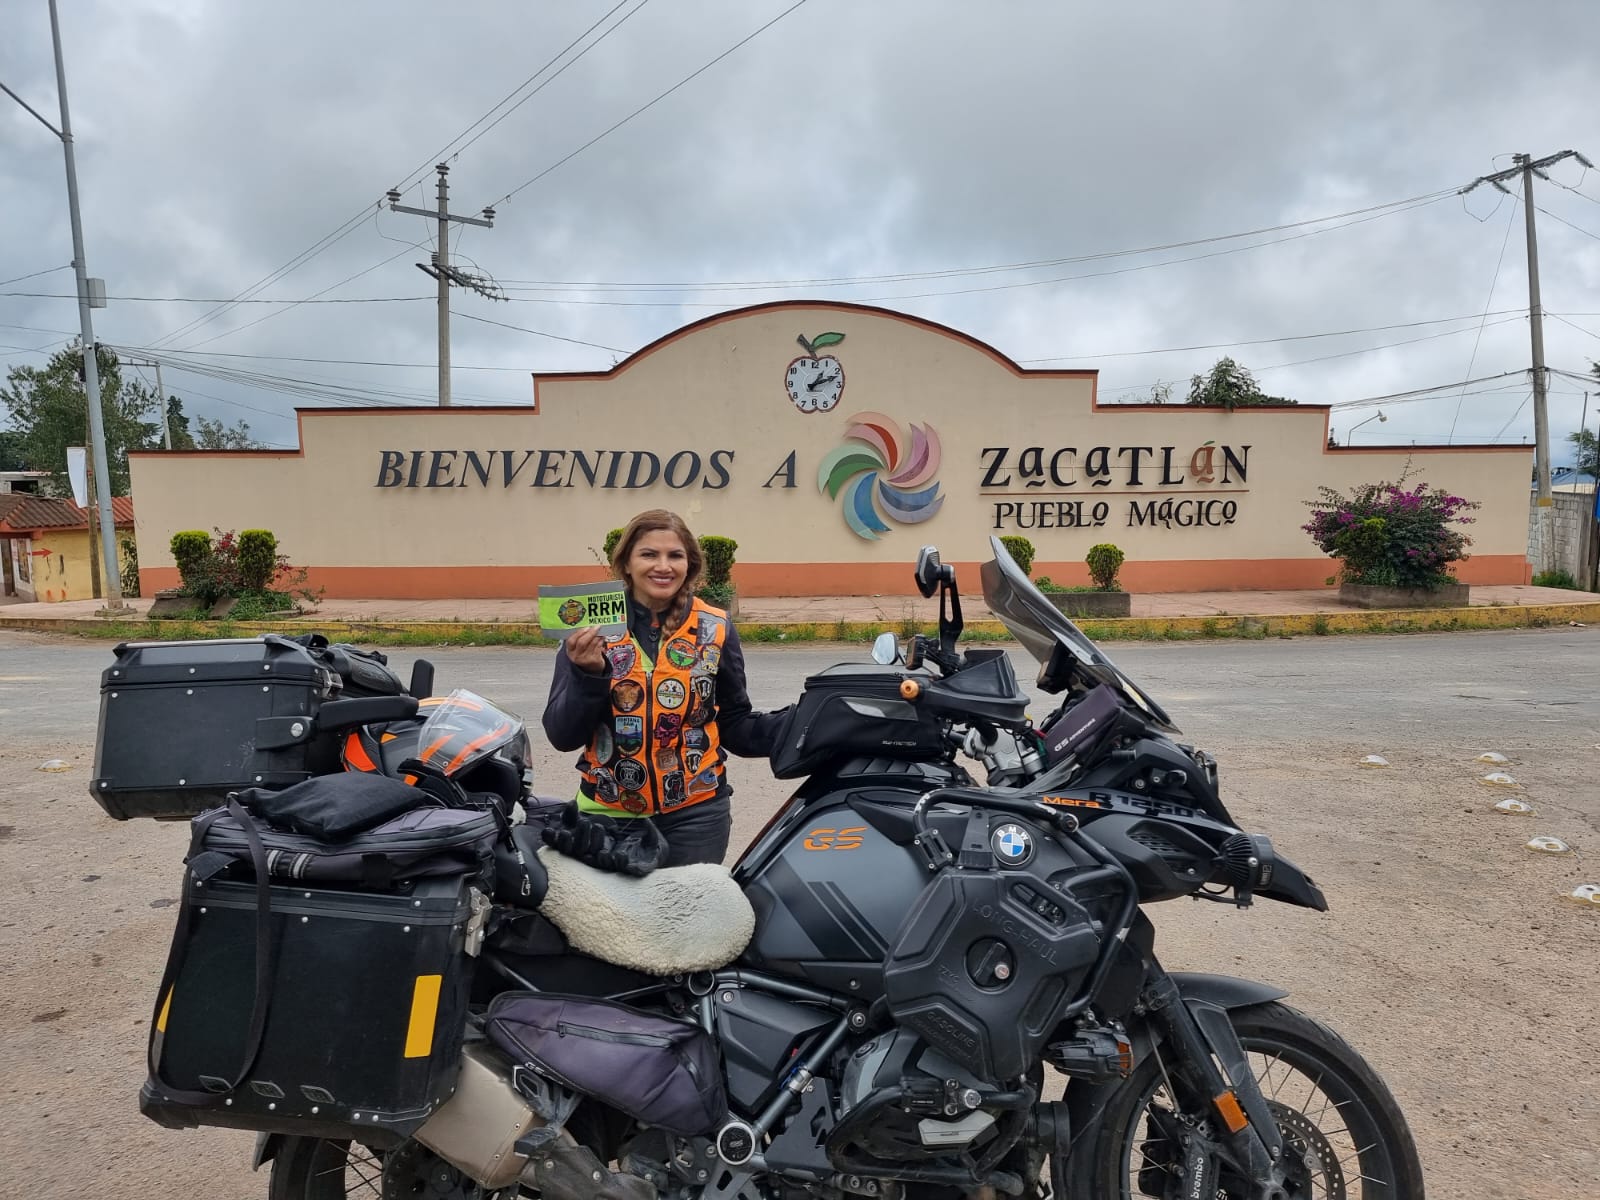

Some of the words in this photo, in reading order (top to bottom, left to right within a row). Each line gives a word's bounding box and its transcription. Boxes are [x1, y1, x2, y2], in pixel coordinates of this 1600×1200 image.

[811, 361, 819, 369] 12
[790, 367, 797, 375] 10
[834, 367, 841, 375] 2
[787, 380, 794, 388] 9
[836, 381, 842, 389] 3
[792, 391, 798, 399] 8
[800, 400, 806, 408] 7
[811, 398, 817, 406] 6
[822, 400, 829, 408] 5
[373, 449, 736, 489] BIENVENIDOS
[761, 449, 799, 489] A
[588, 600, 625, 617] RRM
[1042, 795, 1101, 809] Mera
[996, 825, 1029, 841] BMW
[803, 825, 868, 851] GS
[1190, 1157, 1204, 1199] brembo
